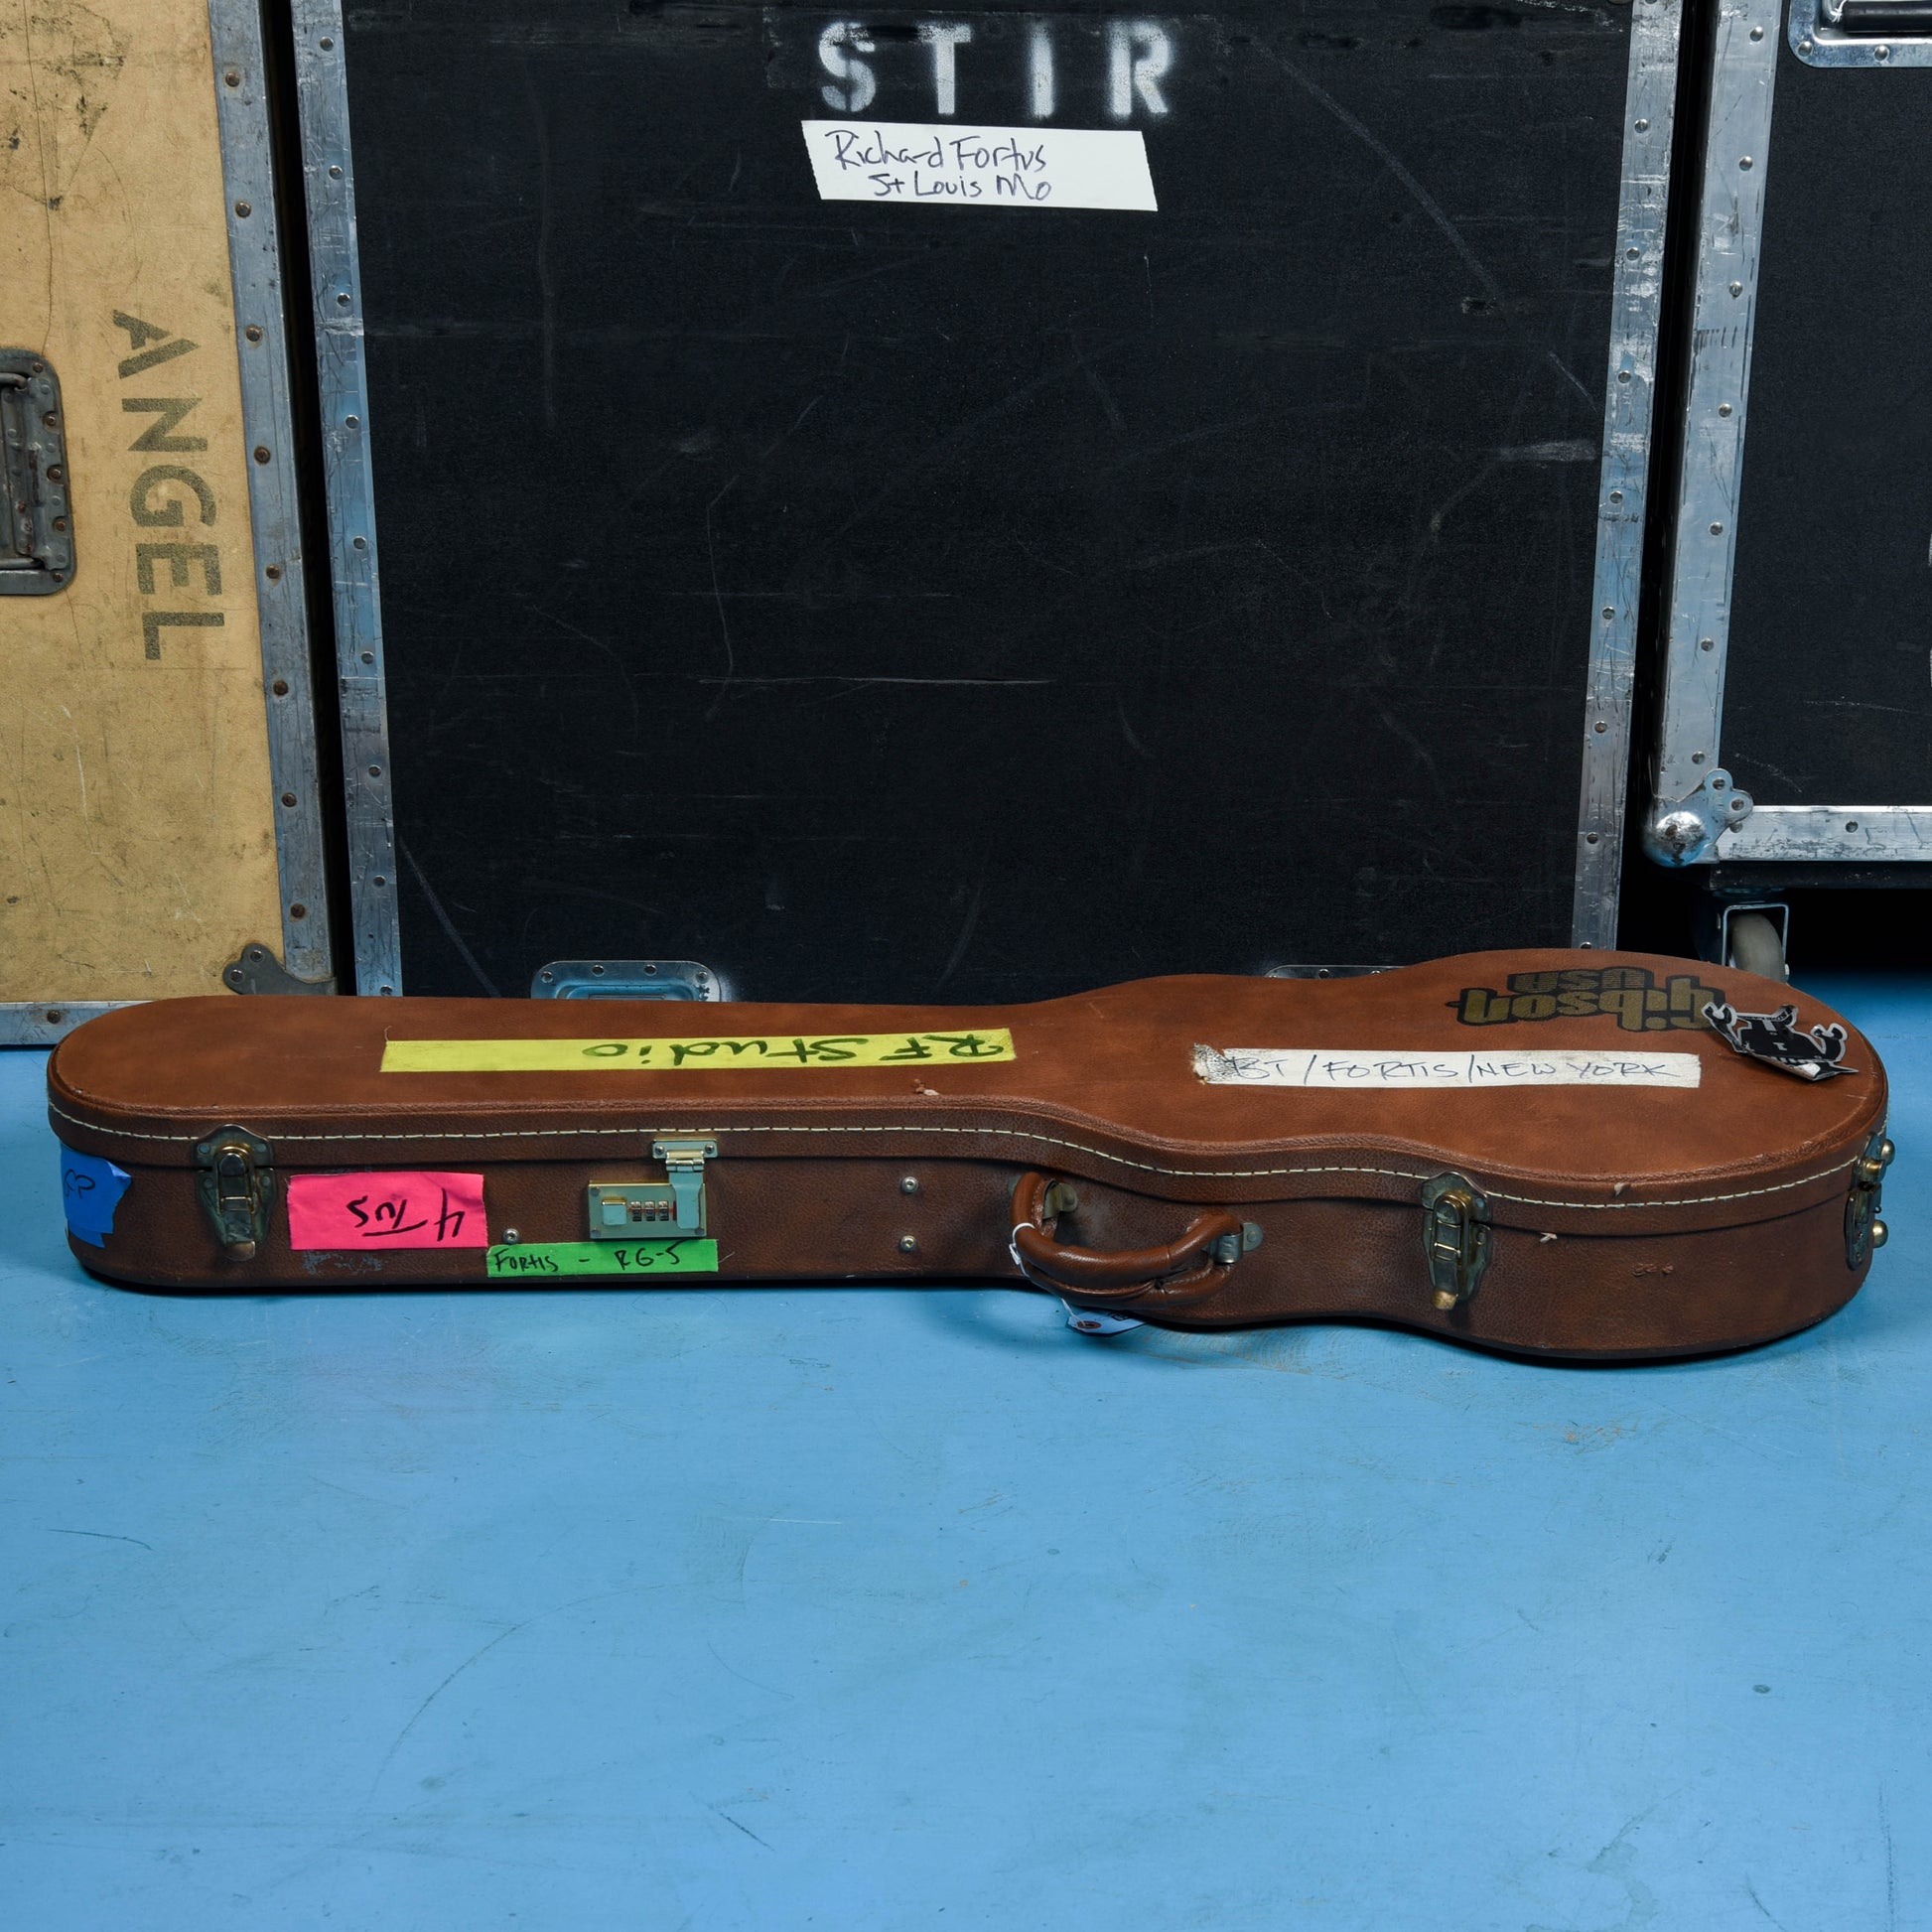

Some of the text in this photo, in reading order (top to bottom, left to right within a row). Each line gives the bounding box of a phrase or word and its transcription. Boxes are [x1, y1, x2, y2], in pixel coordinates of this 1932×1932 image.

[818, 21, 1173, 117] STIR
[824, 129, 943, 170] Richard
[868, 173, 902, 198] St
[912, 170, 983, 198] Louis
[112, 310, 224, 660] ANGEL
[582, 1034, 1005, 1067] RF Studio
[1566, 1059, 1681, 1079] YORK
[434, 1188, 465, 1242] 4
